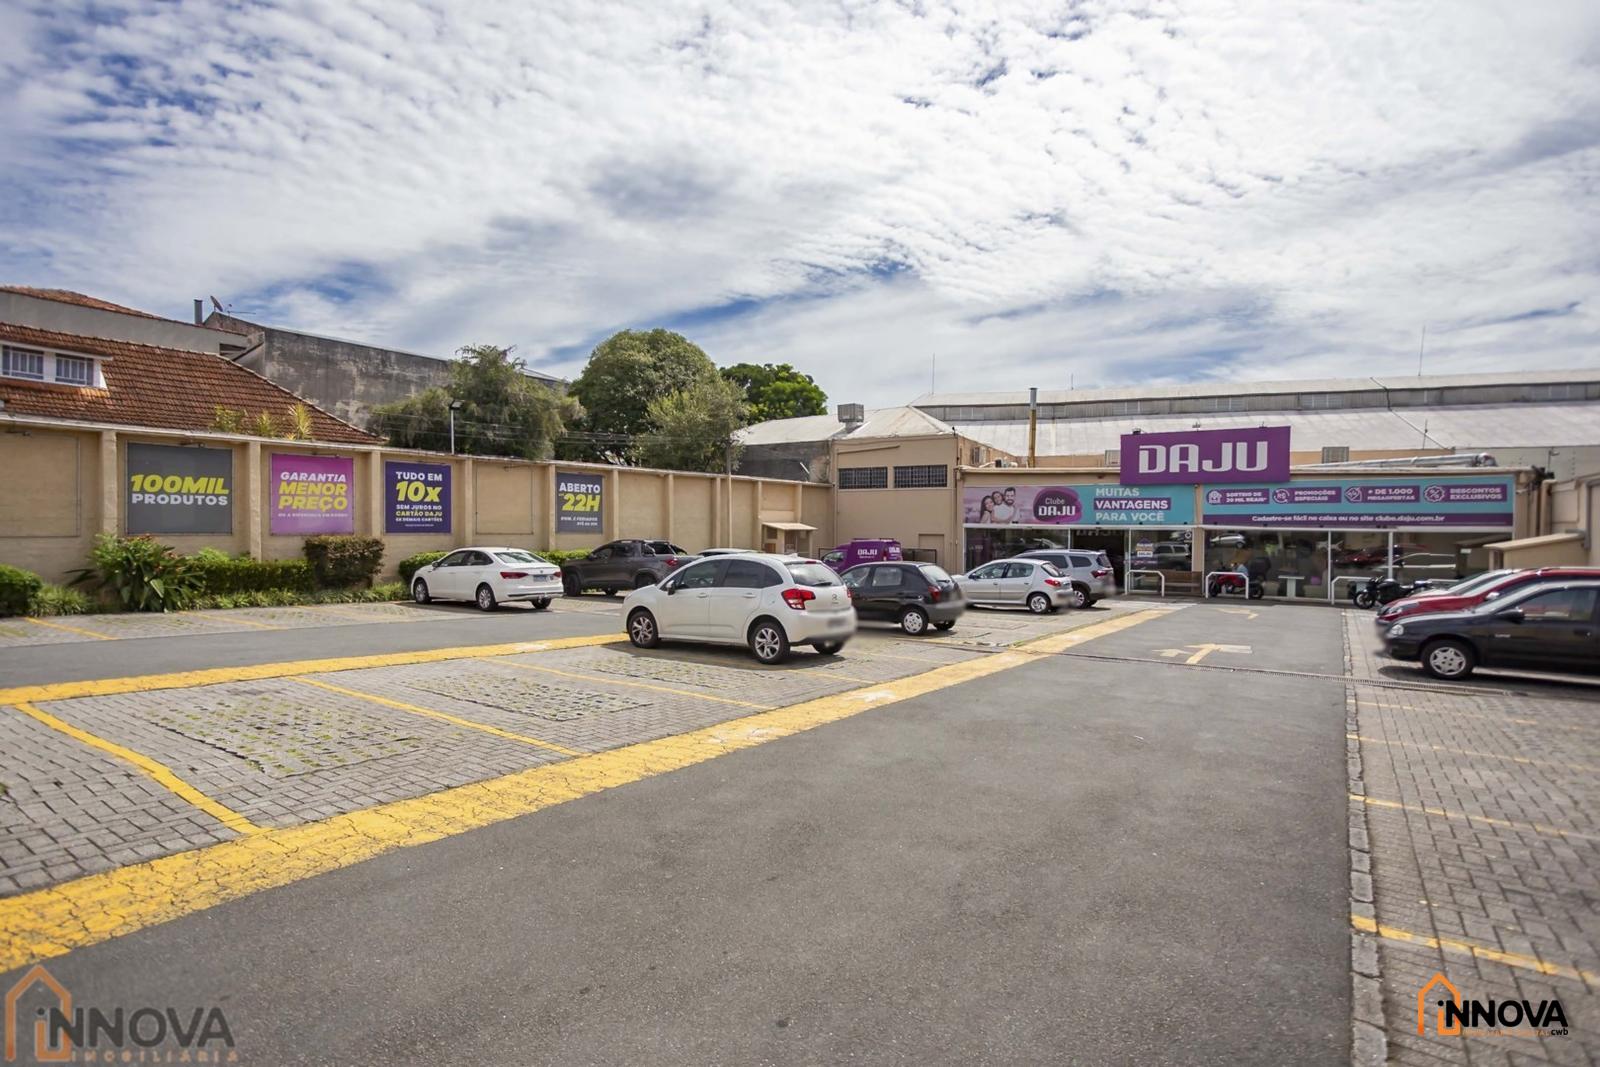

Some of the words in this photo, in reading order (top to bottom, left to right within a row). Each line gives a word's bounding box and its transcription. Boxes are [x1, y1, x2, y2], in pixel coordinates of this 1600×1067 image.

[1139, 441, 1268, 473] DAJU
[280, 471, 347, 483] GARANTIA
[396, 471, 425, 481] TUDO
[428, 473, 442, 482] EM
[131, 474, 229, 495] 100MIL
[279, 481, 348, 496] MENOR
[559, 482, 600, 493] ABERTO
[1096, 488, 1140, 497] MUITAS
[131, 493, 229, 506] PRODUTOS
[278, 496, 348, 513] PREÇO
[561, 493, 600, 512] 22H
[1045, 497, 1065, 505] Clube
[1096, 500, 1169, 510] VANTAGENS
[396, 509, 424, 517] CARTÃO
[1038, 506, 1076, 516] DAJU
[1096, 513, 1127, 521] PARA
[1131, 511, 1165, 522] VOCÊ
